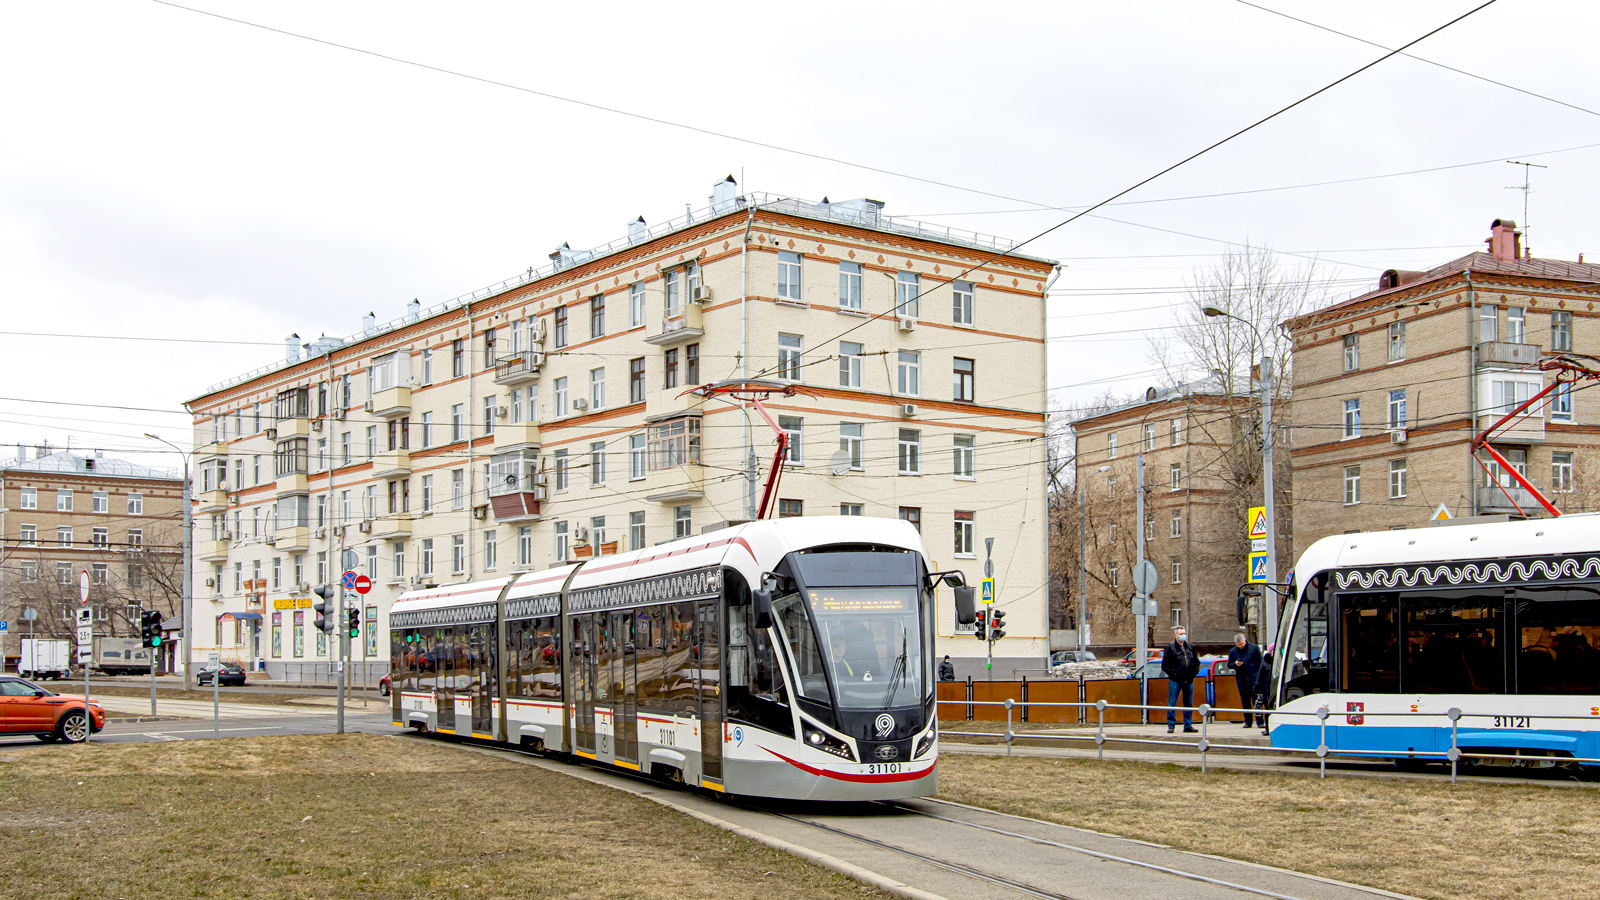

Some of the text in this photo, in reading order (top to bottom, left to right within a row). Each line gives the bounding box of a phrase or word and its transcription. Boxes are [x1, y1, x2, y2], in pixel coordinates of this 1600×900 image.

[1494, 716, 1530, 728] 31121
[660, 728, 675, 746] 31101
[868, 764, 901, 774] 31101
